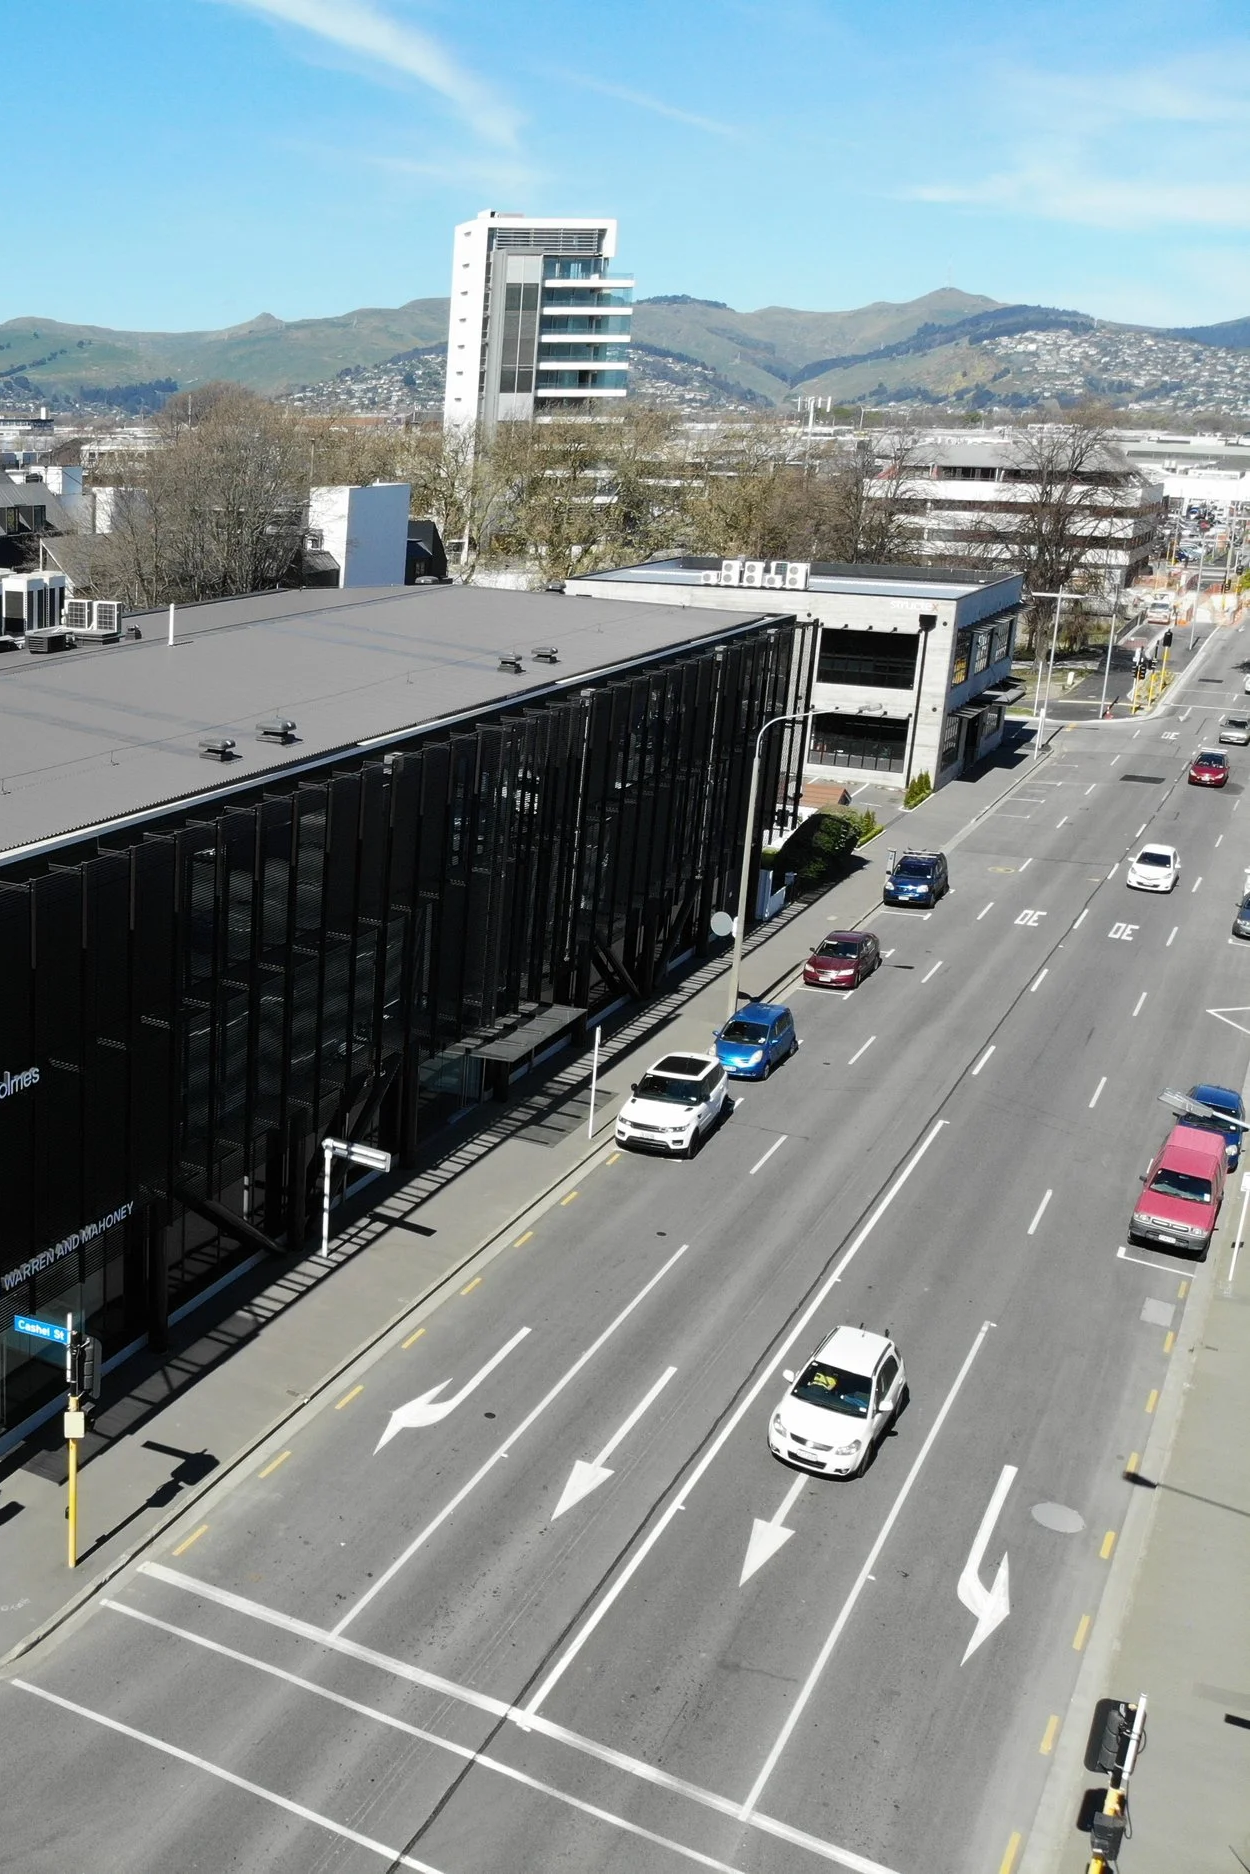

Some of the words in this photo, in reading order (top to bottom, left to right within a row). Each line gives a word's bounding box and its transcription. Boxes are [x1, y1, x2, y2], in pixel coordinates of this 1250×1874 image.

[1, 1248, 55, 1291] WARREN
[55, 1233, 80, 1260] AND
[79, 1200, 134, 1244] MAHONEY
[17, 1319, 50, 1337] Cashel
[53, 1329, 65, 1341] St
